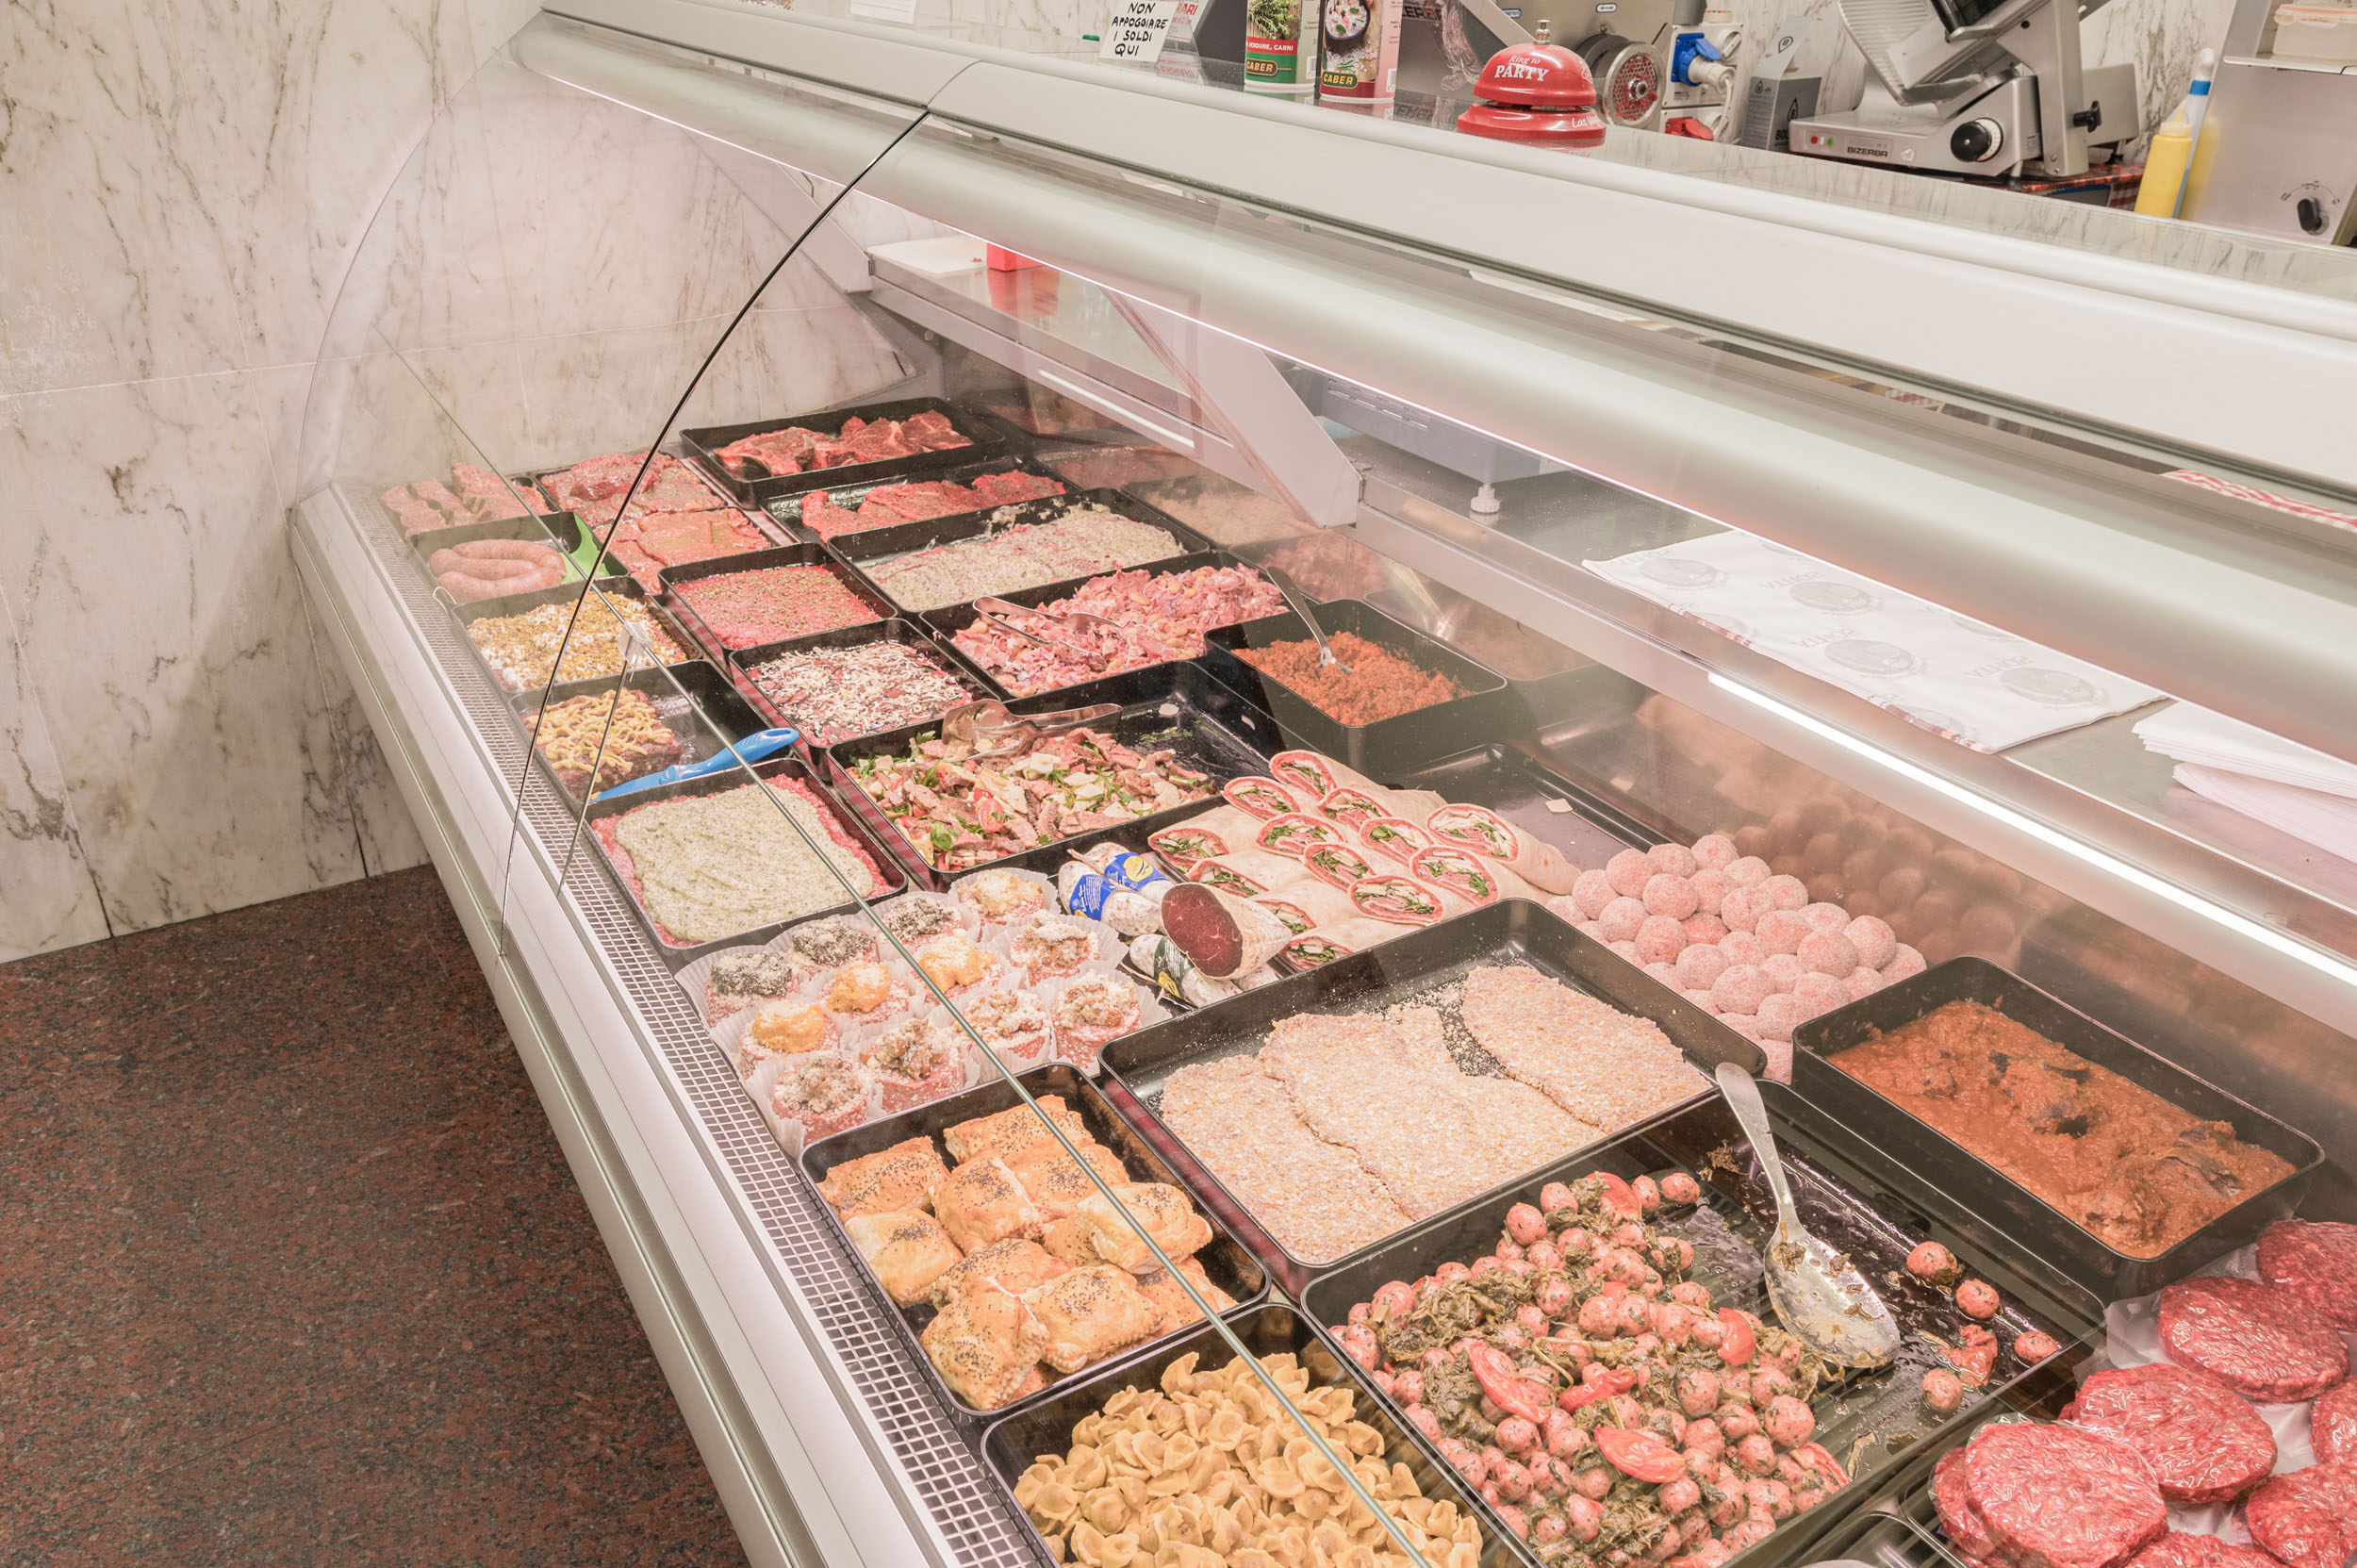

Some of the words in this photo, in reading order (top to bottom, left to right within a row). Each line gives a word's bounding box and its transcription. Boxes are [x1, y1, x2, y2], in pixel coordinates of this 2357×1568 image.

[1128, 2, 1156, 14] NON
[1112, 16, 1168, 29] APPOGGIARE
[1113, 31, 1118, 41] I
[1123, 30, 1153, 41] SOLDI
[1115, 43, 1139, 57] QUI
[1509, 55, 1529, 65] Ring
[1245, 60, 1274, 73] CABER
[1494, 65, 1549, 81] PARTY
[1323, 74, 1354, 85] CABER
[1847, 146, 1888, 157] BIZERBA
